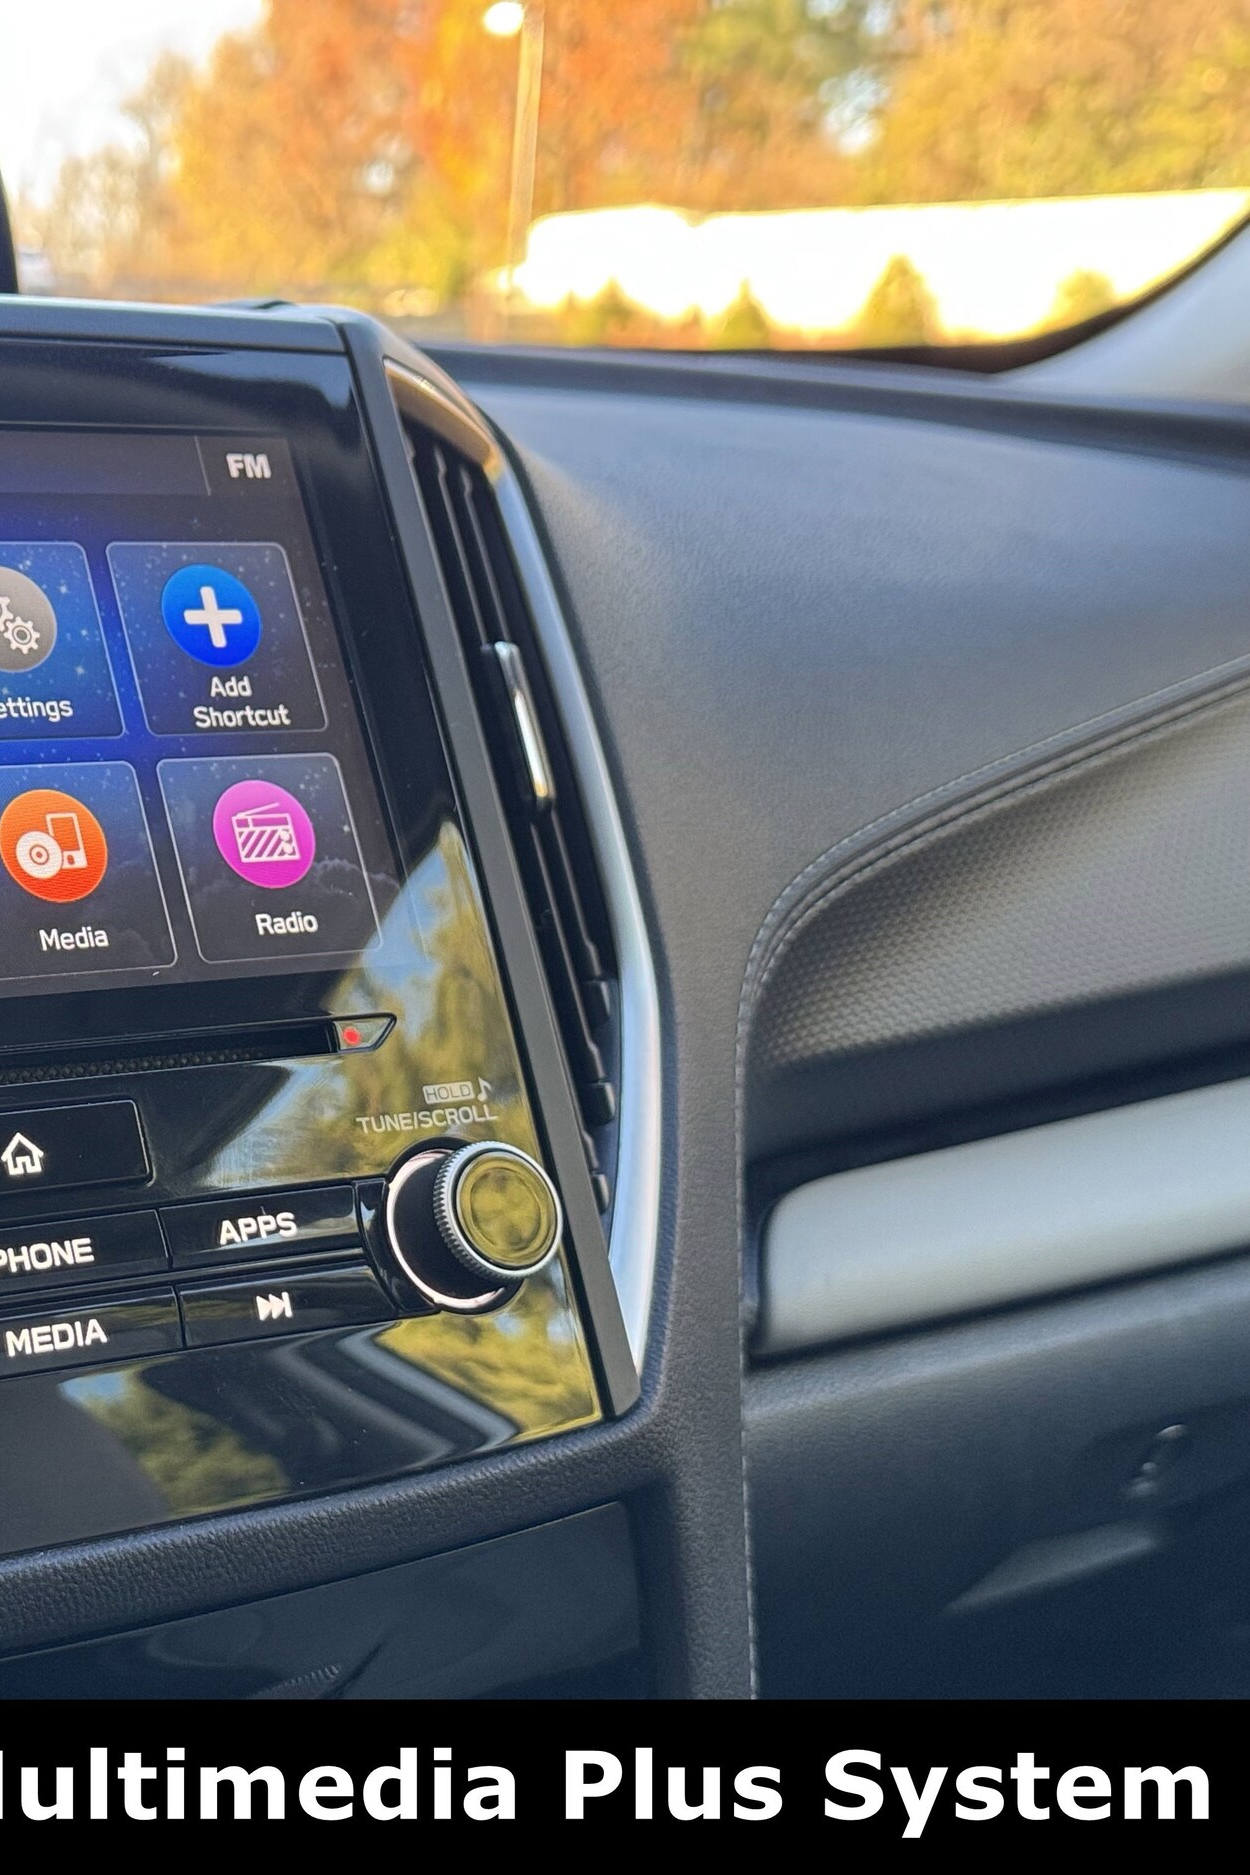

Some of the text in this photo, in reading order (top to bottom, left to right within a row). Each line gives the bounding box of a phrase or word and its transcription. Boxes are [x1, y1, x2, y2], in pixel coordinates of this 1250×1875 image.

[227, 453, 272, 479] FM
[210, 676, 252, 698] Add
[193, 704, 291, 730] Shortcut
[255, 911, 319, 936] Radio
[39, 926, 109, 951] Media
[425, 1084, 473, 1101] HOLD
[355, 1104, 498, 1134] TUNE/SCROLL
[219, 1212, 297, 1245] APPS
[5, 1319, 108, 1357] MEDIA
